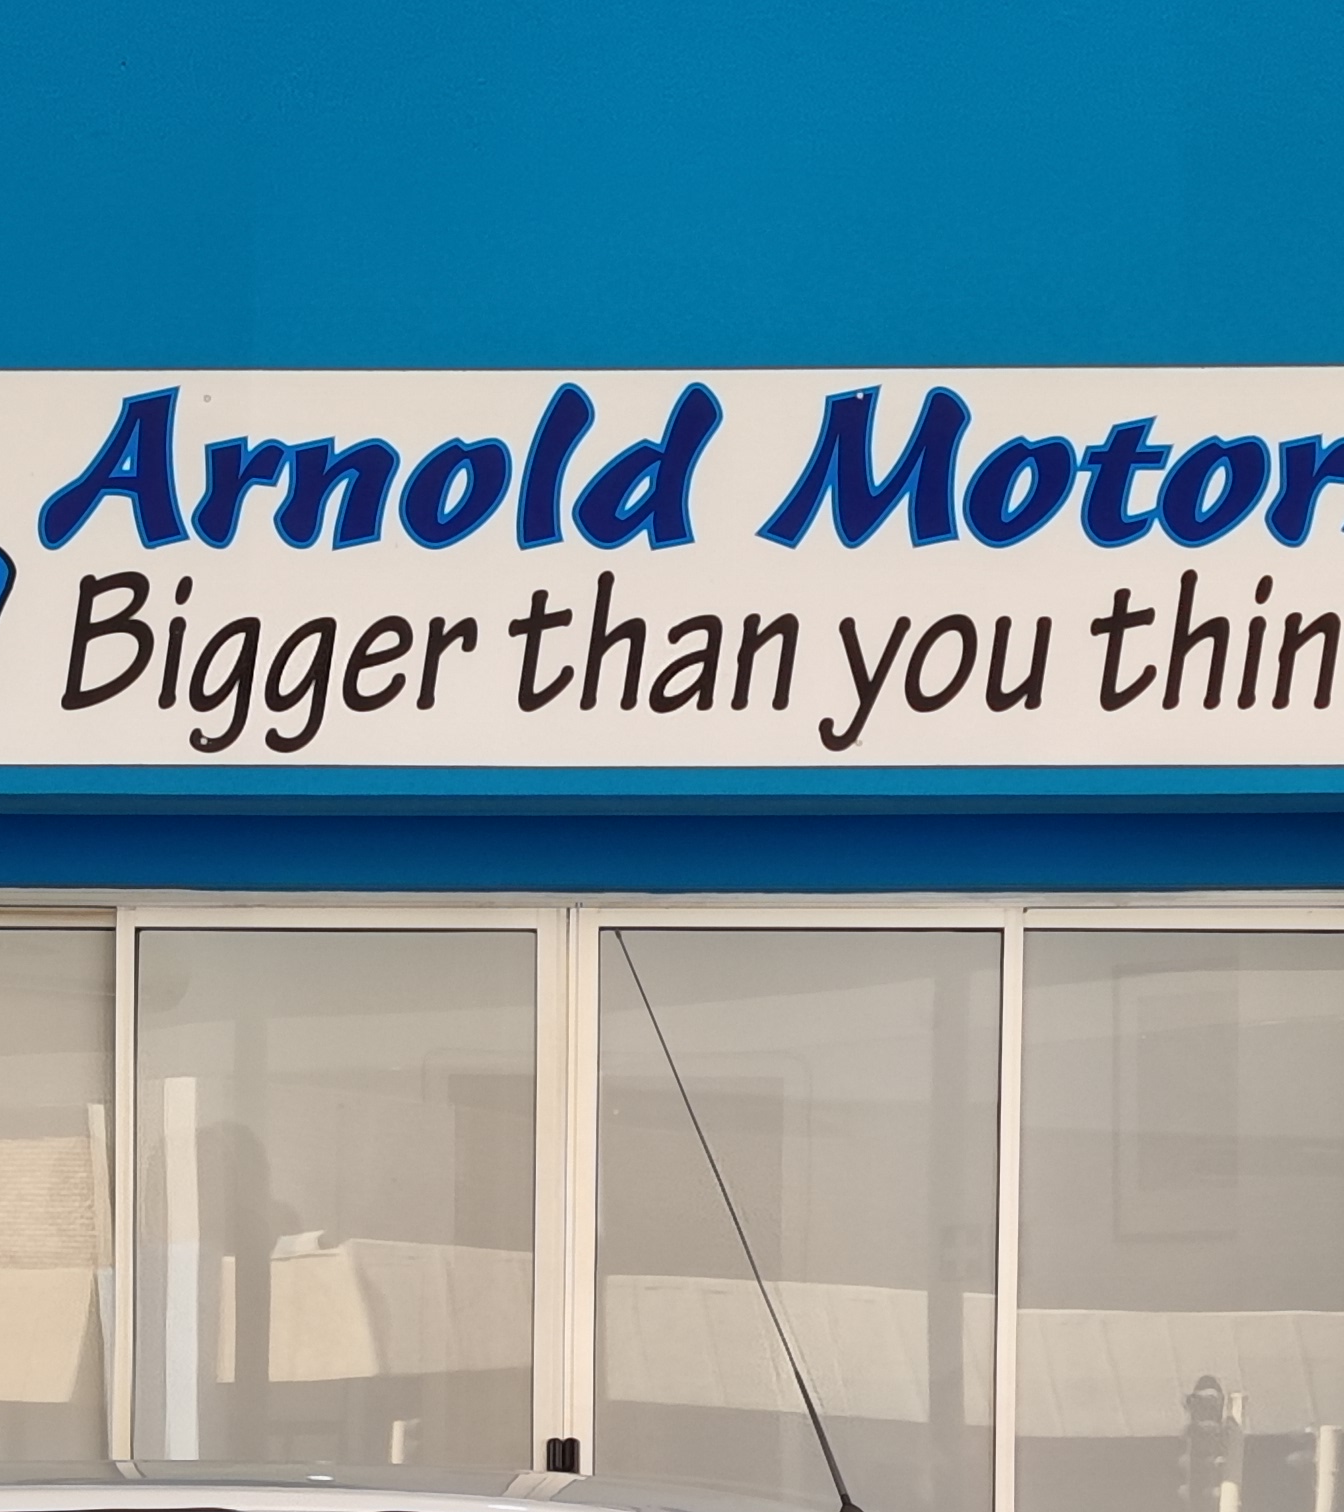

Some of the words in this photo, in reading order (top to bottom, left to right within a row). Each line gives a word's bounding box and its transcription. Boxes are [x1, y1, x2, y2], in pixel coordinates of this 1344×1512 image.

[37, 382, 723, 551] Arnold
[60, 570, 478, 753] Bigger
[508, 570, 800, 712] than
[817, 615, 1054, 752] you
